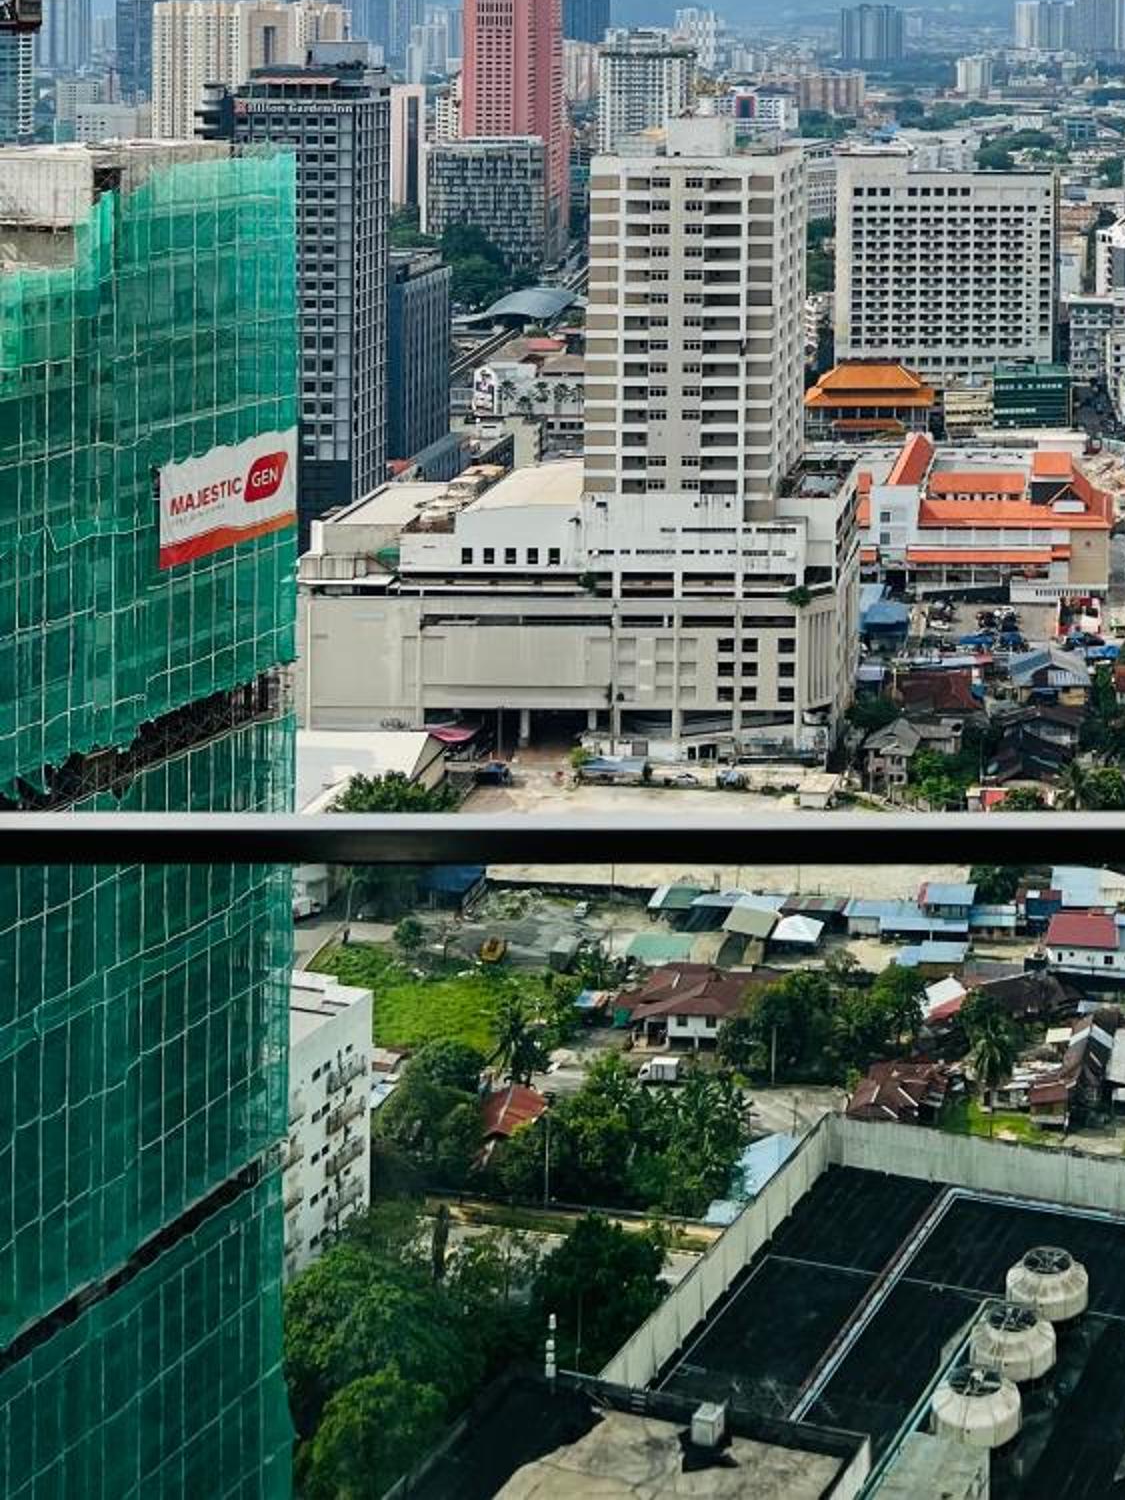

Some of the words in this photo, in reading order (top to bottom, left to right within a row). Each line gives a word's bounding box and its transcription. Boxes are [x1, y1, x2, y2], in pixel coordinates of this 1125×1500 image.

[332, 103, 353, 113] Inn
[170, 477, 243, 515] MAJESTIC
[251, 467, 279, 487] GEN
